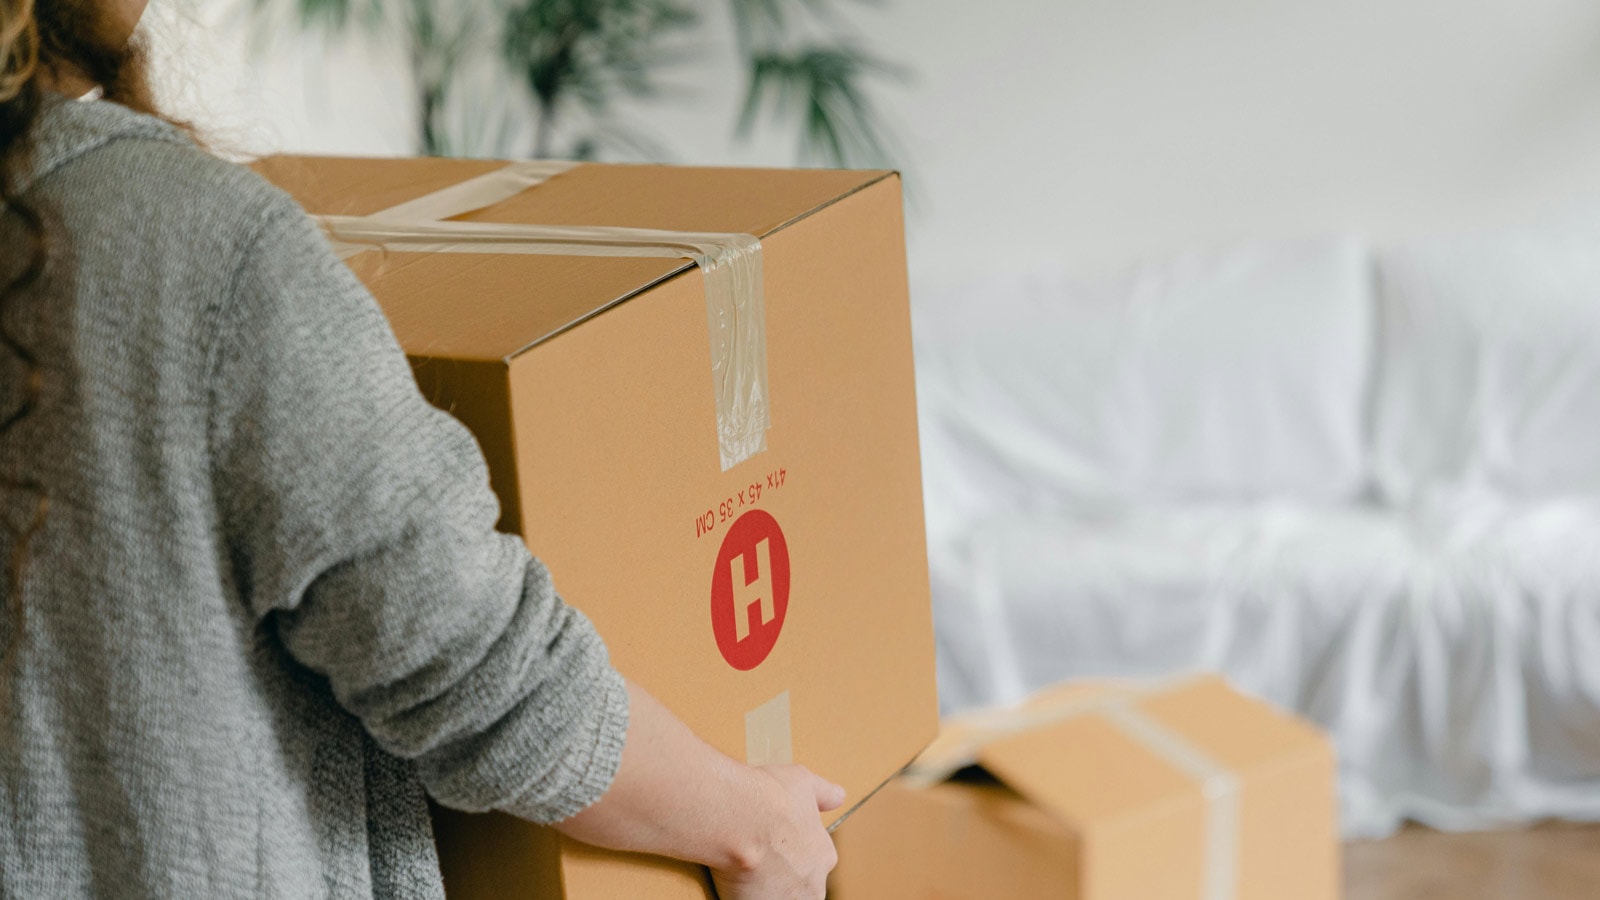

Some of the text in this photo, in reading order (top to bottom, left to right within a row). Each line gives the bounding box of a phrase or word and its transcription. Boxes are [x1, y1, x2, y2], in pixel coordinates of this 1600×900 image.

[737, 490, 745, 507] x
[748, 482, 762, 505] 45
[719, 497, 734, 523] 35
[695, 509, 715, 538] CM
[730, 537, 775, 643] H
